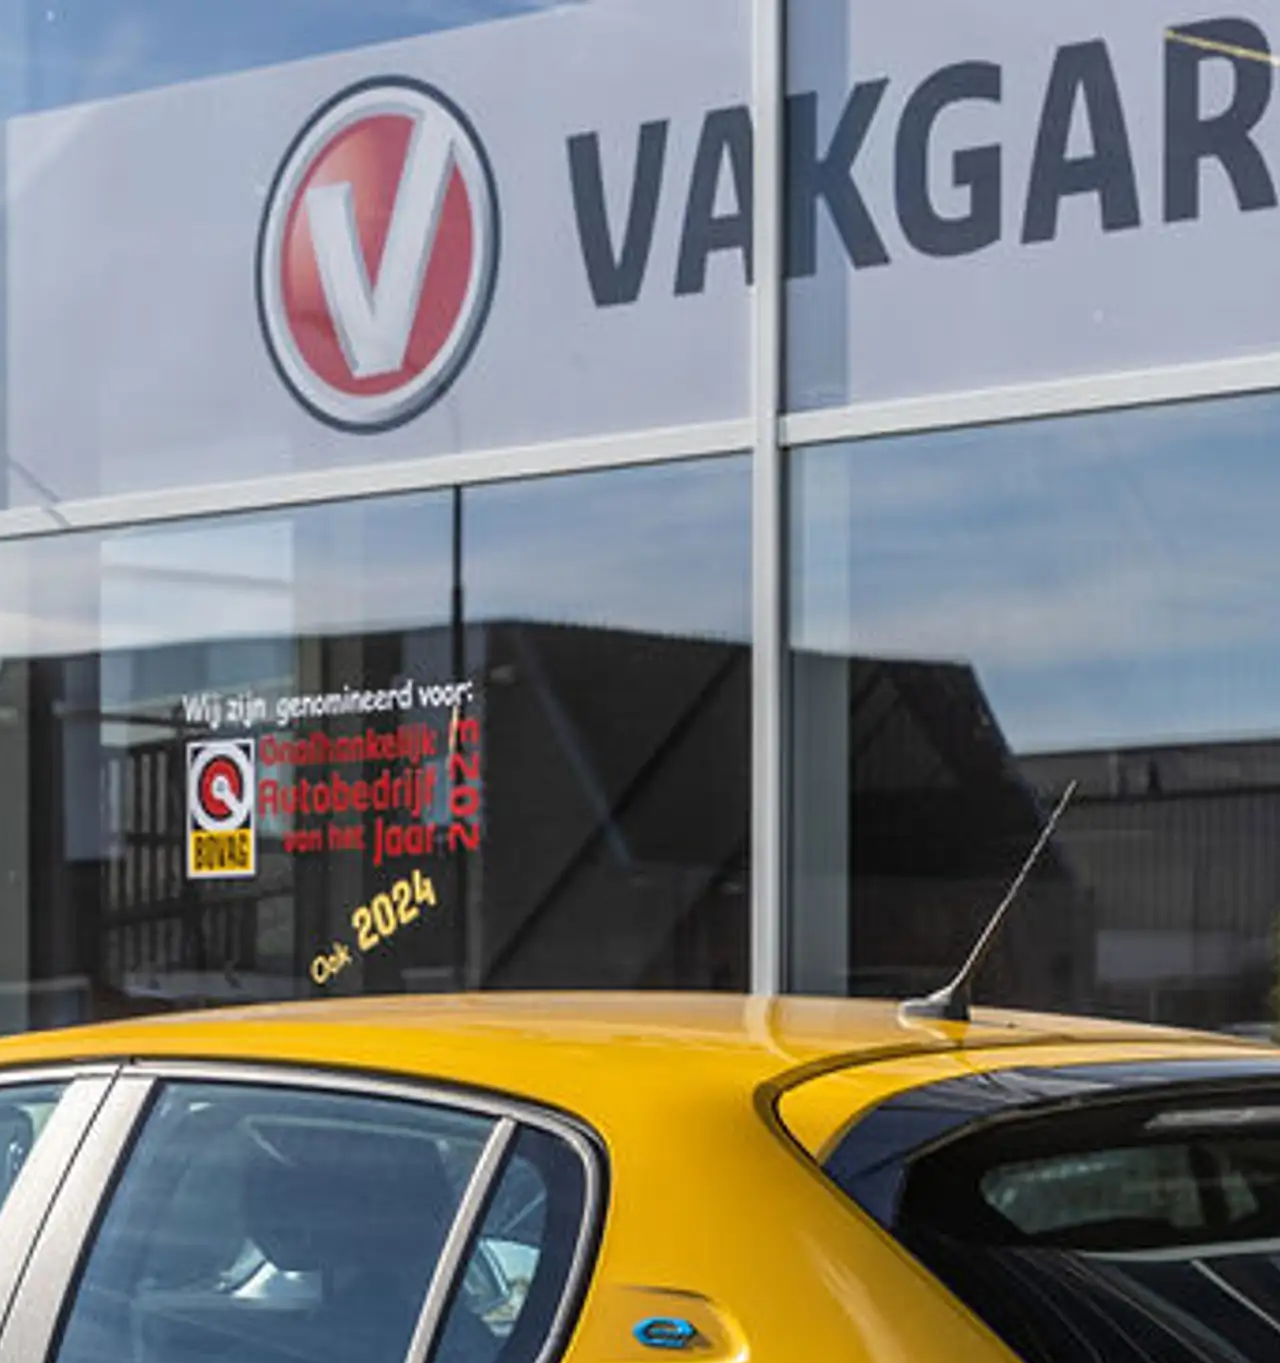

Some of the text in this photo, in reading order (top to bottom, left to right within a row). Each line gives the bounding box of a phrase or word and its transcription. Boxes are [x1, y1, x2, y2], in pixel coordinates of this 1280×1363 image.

[182, 679, 473, 730] Wij zijn genomineerd voor:
[259, 766, 437, 817] Autobedrijf
[449, 716, 481, 853] 2023
[194, 833, 249, 872] BOVAG
[351, 869, 438, 952] 2024
